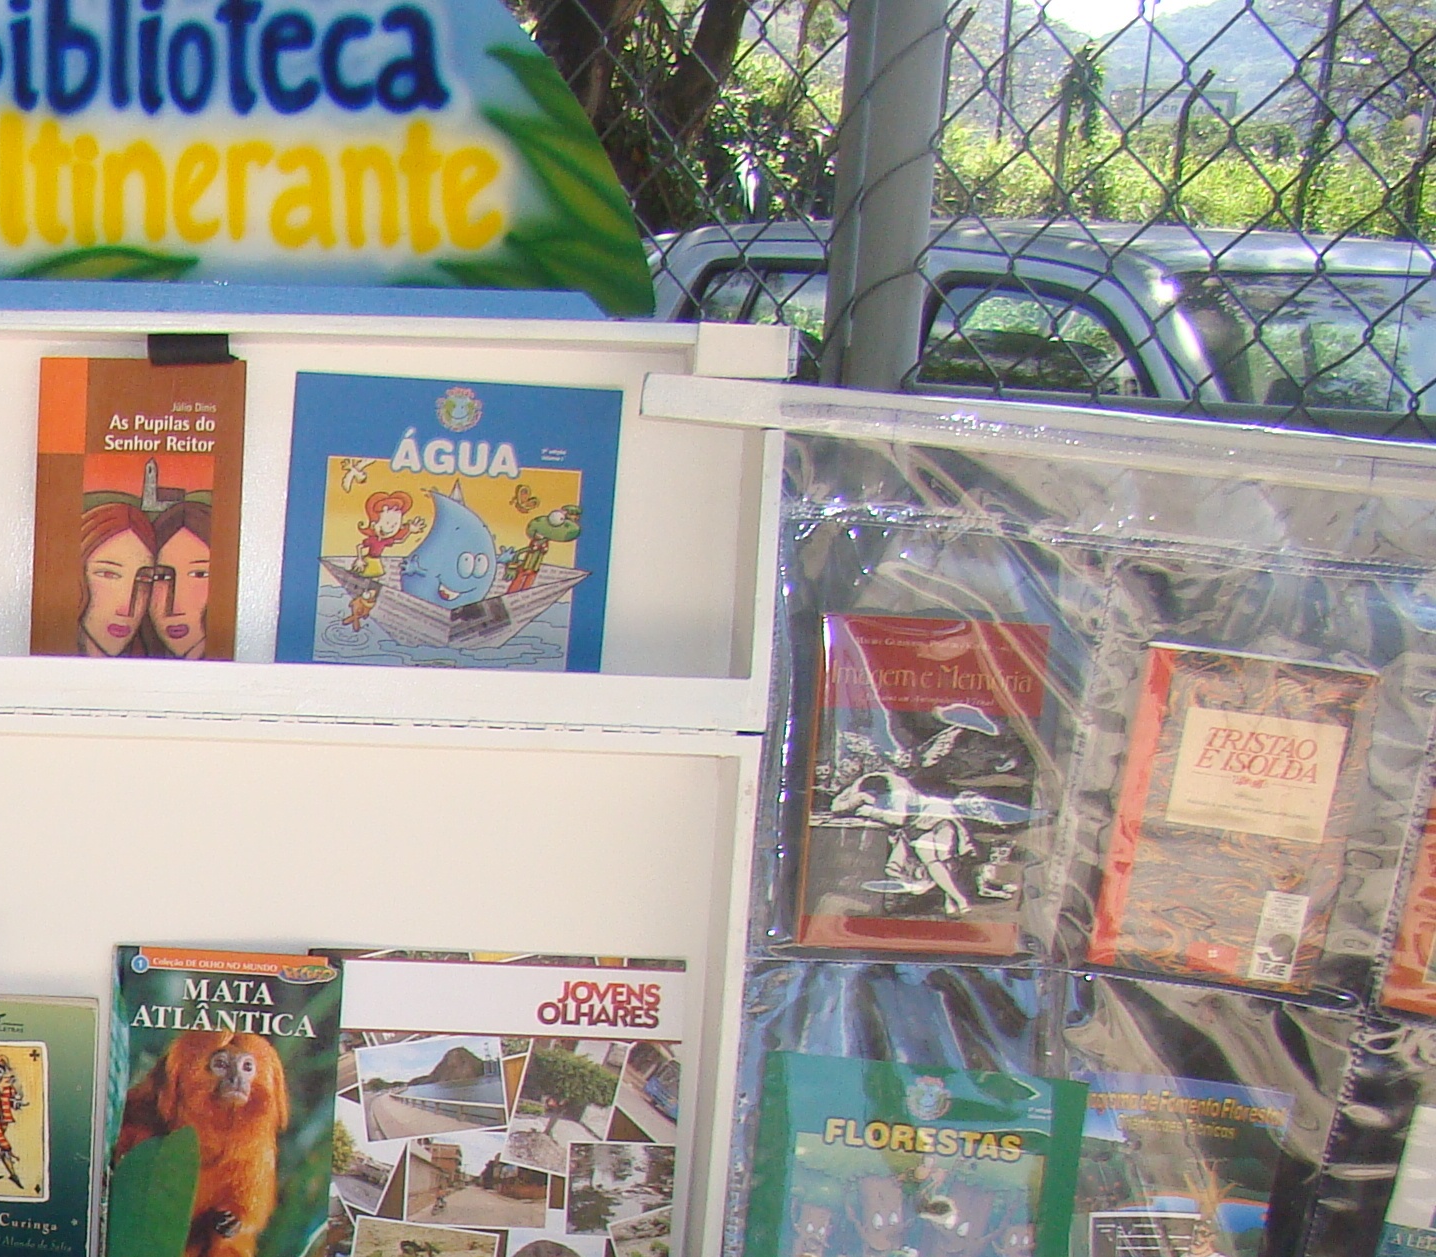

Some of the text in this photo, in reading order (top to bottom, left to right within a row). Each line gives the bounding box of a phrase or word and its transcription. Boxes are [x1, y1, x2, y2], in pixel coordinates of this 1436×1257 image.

[109, 414, 215, 434] As Pupilas do
[104, 434, 214, 452] Senhor Reitor
[390, 427, 519, 478] ÁGUA
[832, 659, 914, 690] Imagem
[921, 671, 933, 688] e
[1195, 748, 1318, 784] E ISOLDA
[137, 957, 277, 972] 1 Coleção DE OLHO NO MUNDO
[182, 978, 274, 1006] MATA
[557, 980, 661, 1008] JOVENS
[130, 1003, 317, 1038] ATLÂNTICA
[537, 1001, 660, 1029] OLHARES
[1140, 1090, 1158, 1111] de
[1159, 1090, 1222, 1117] Fomento
[823, 1117, 1022, 1162] FLORESTAS
